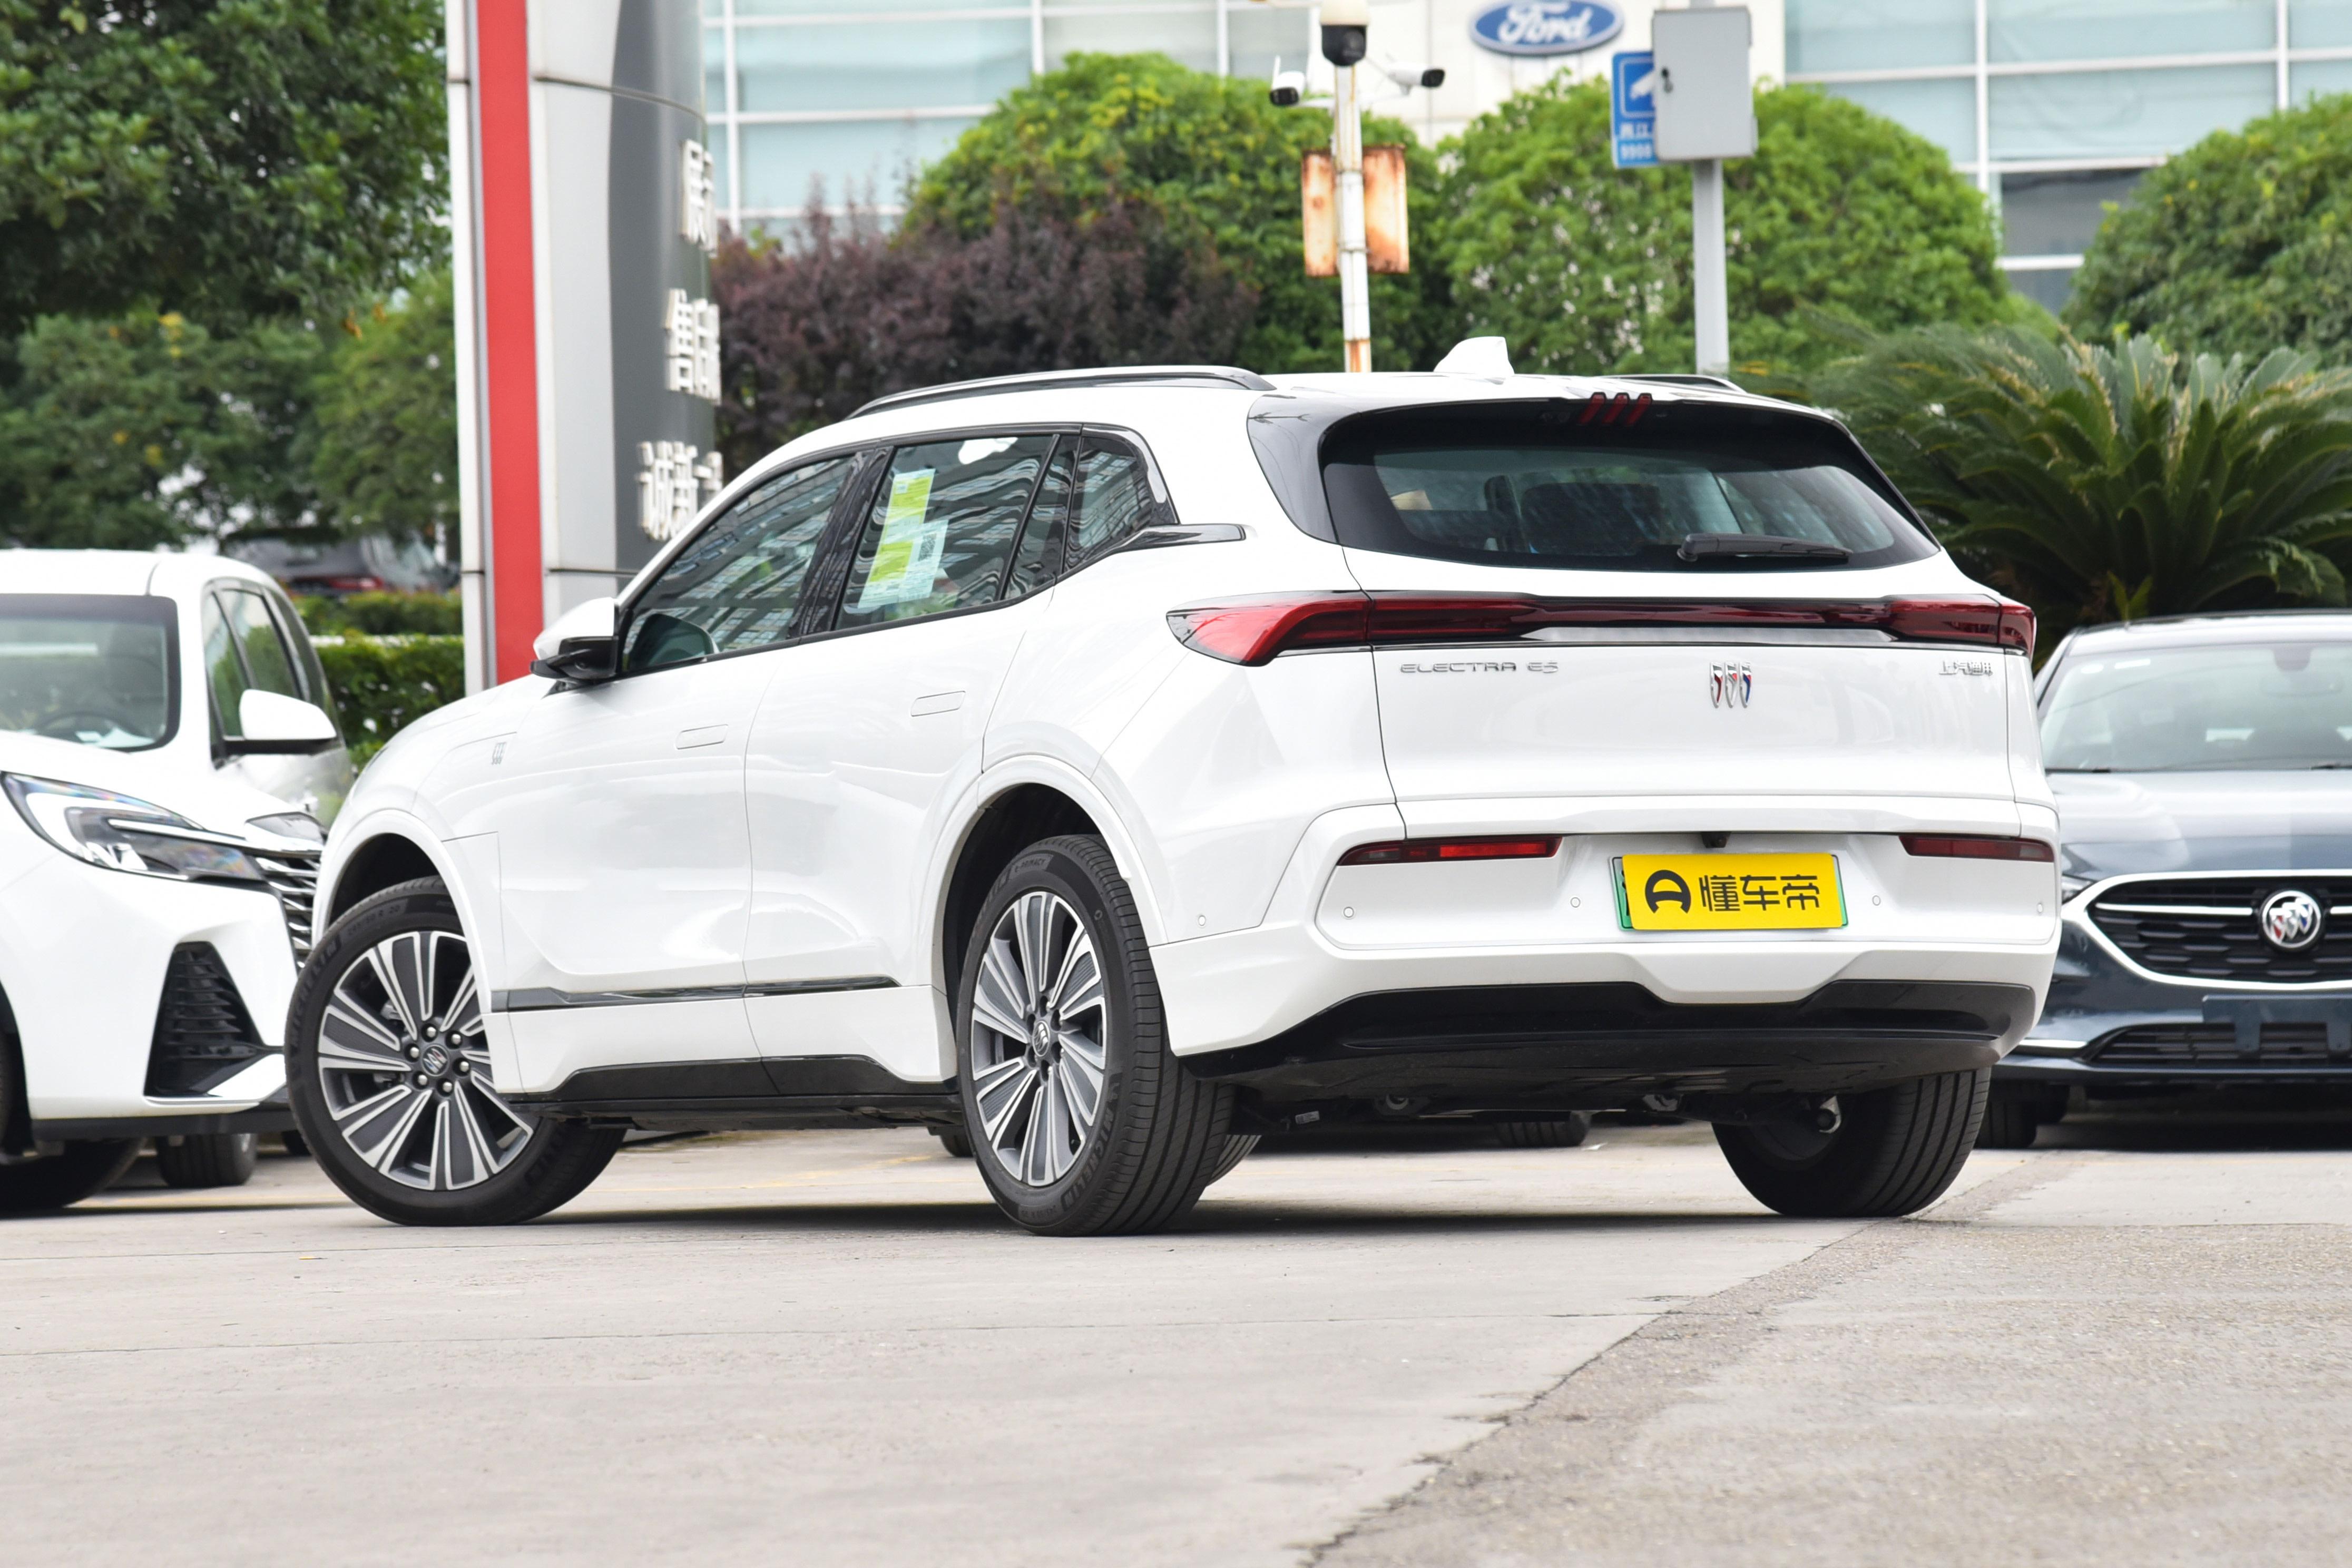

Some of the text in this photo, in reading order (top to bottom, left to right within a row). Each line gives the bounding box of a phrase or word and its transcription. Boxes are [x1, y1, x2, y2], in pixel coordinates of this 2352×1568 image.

[1497, 1, 1593, 44] Ford
[1400, 661, 1559, 673] ELECTRA E5
[1699, 874, 1820, 912] 懂车帝
[1063, 1106, 1115, 1208] MICHELIN
